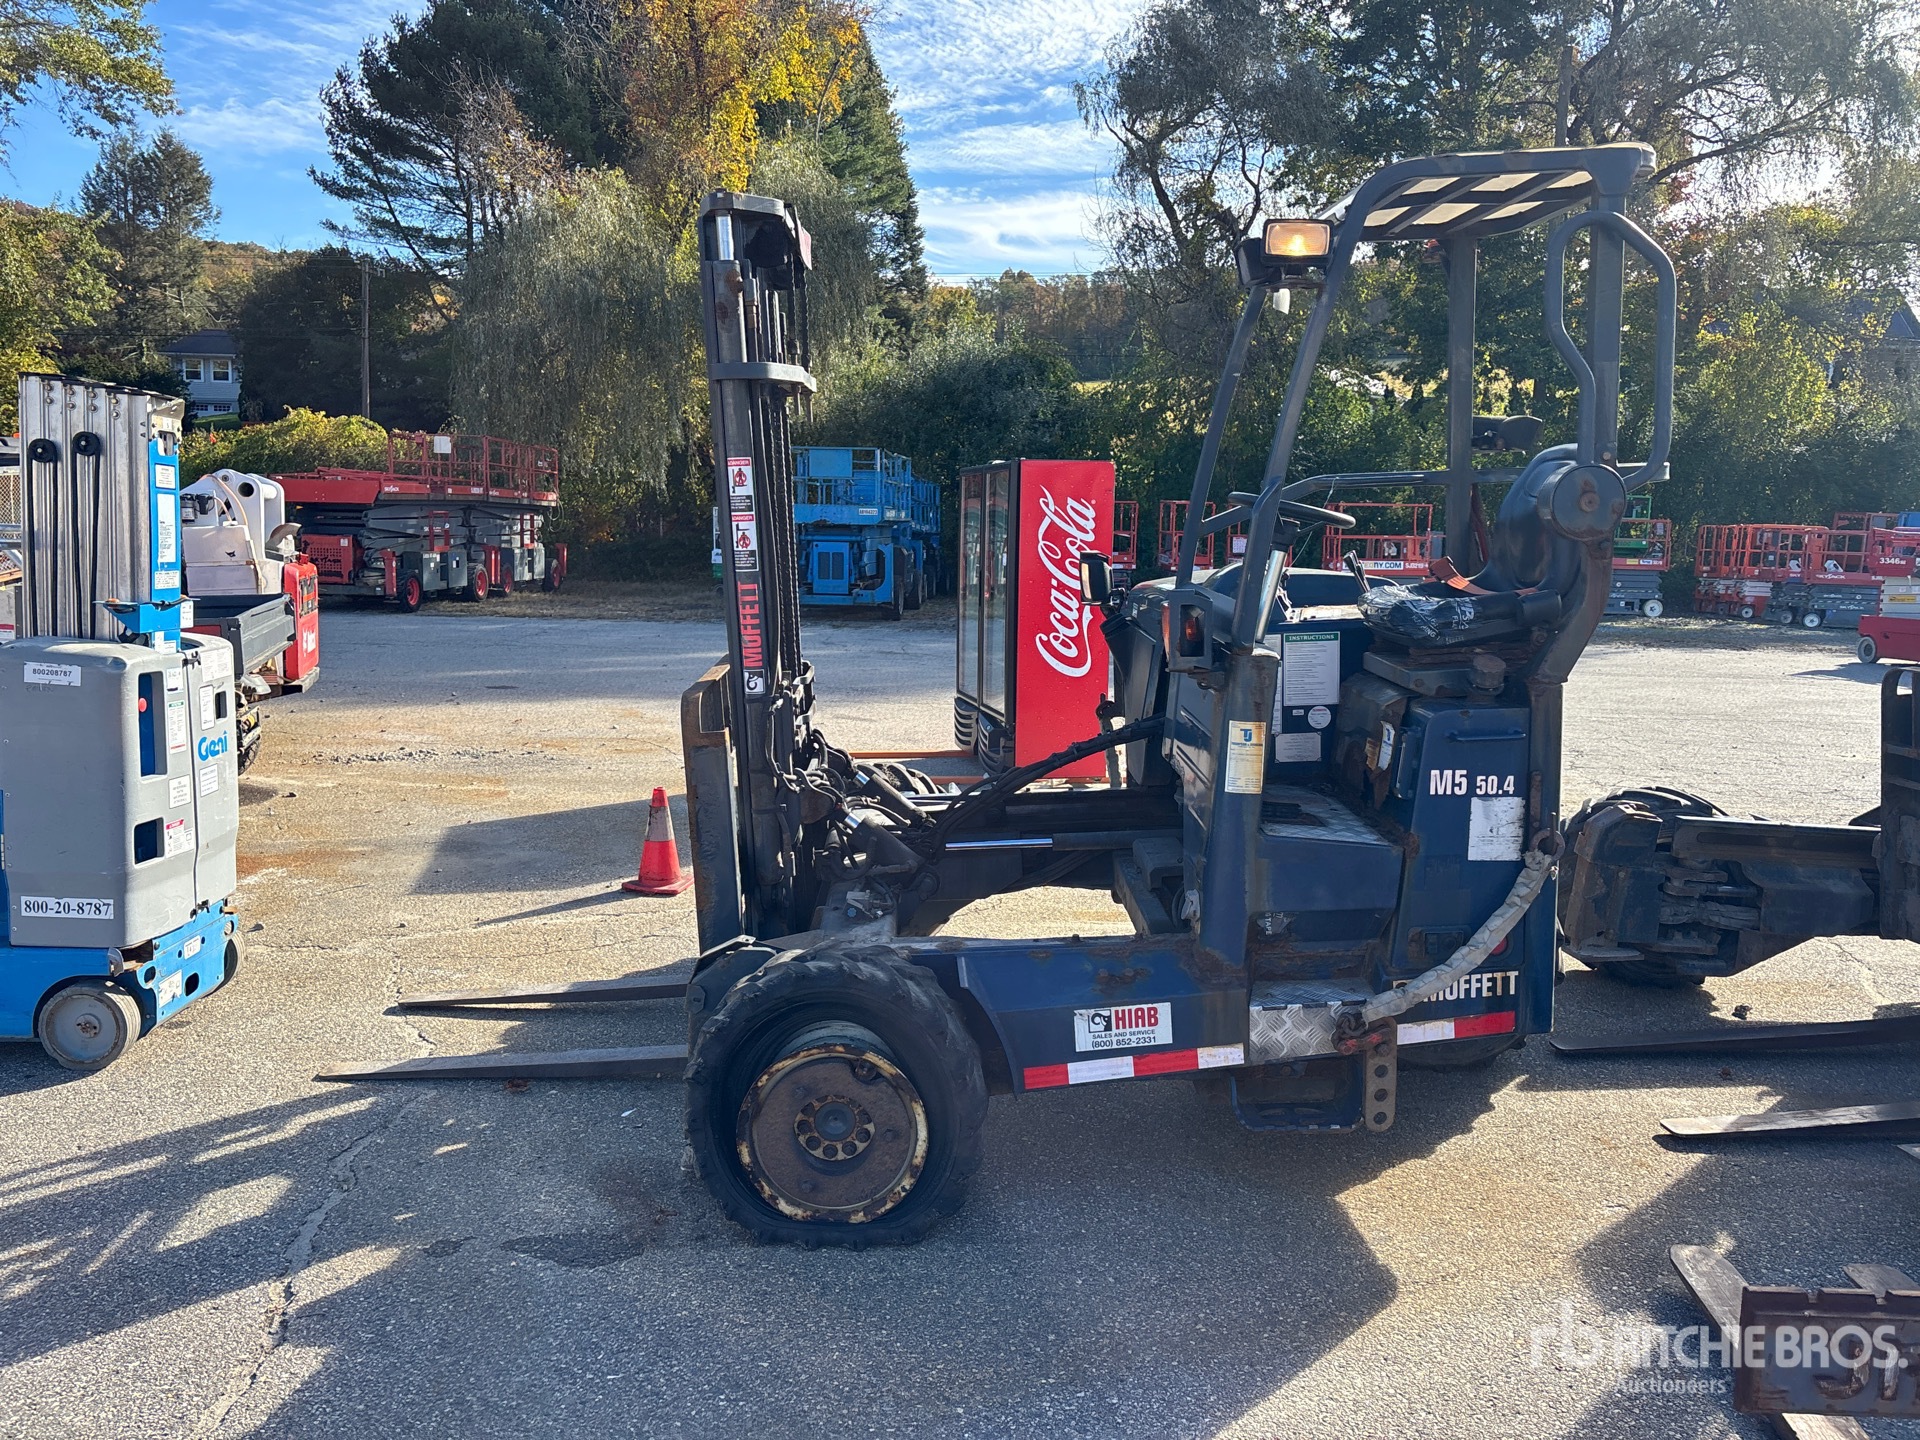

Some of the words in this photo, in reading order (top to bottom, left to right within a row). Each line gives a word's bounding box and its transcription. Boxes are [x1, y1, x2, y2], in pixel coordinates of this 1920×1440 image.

[1035, 485, 1096, 678] Coca-Cola
[738, 582, 763, 667] MOFFETT
[32, 668, 72, 677] 800208787
[1429, 769, 1468, 796] M5
[1476, 775, 1515, 795] 50.4
[24, 900, 111, 916] 800-20-8787
[1115, 1006, 1158, 1030] HIAB
[1091, 1039, 1114, 1049] (800)
[1115, 1036, 1157, 1046] 852-2331
[1128, 1029, 1156, 1037] SERVICE
